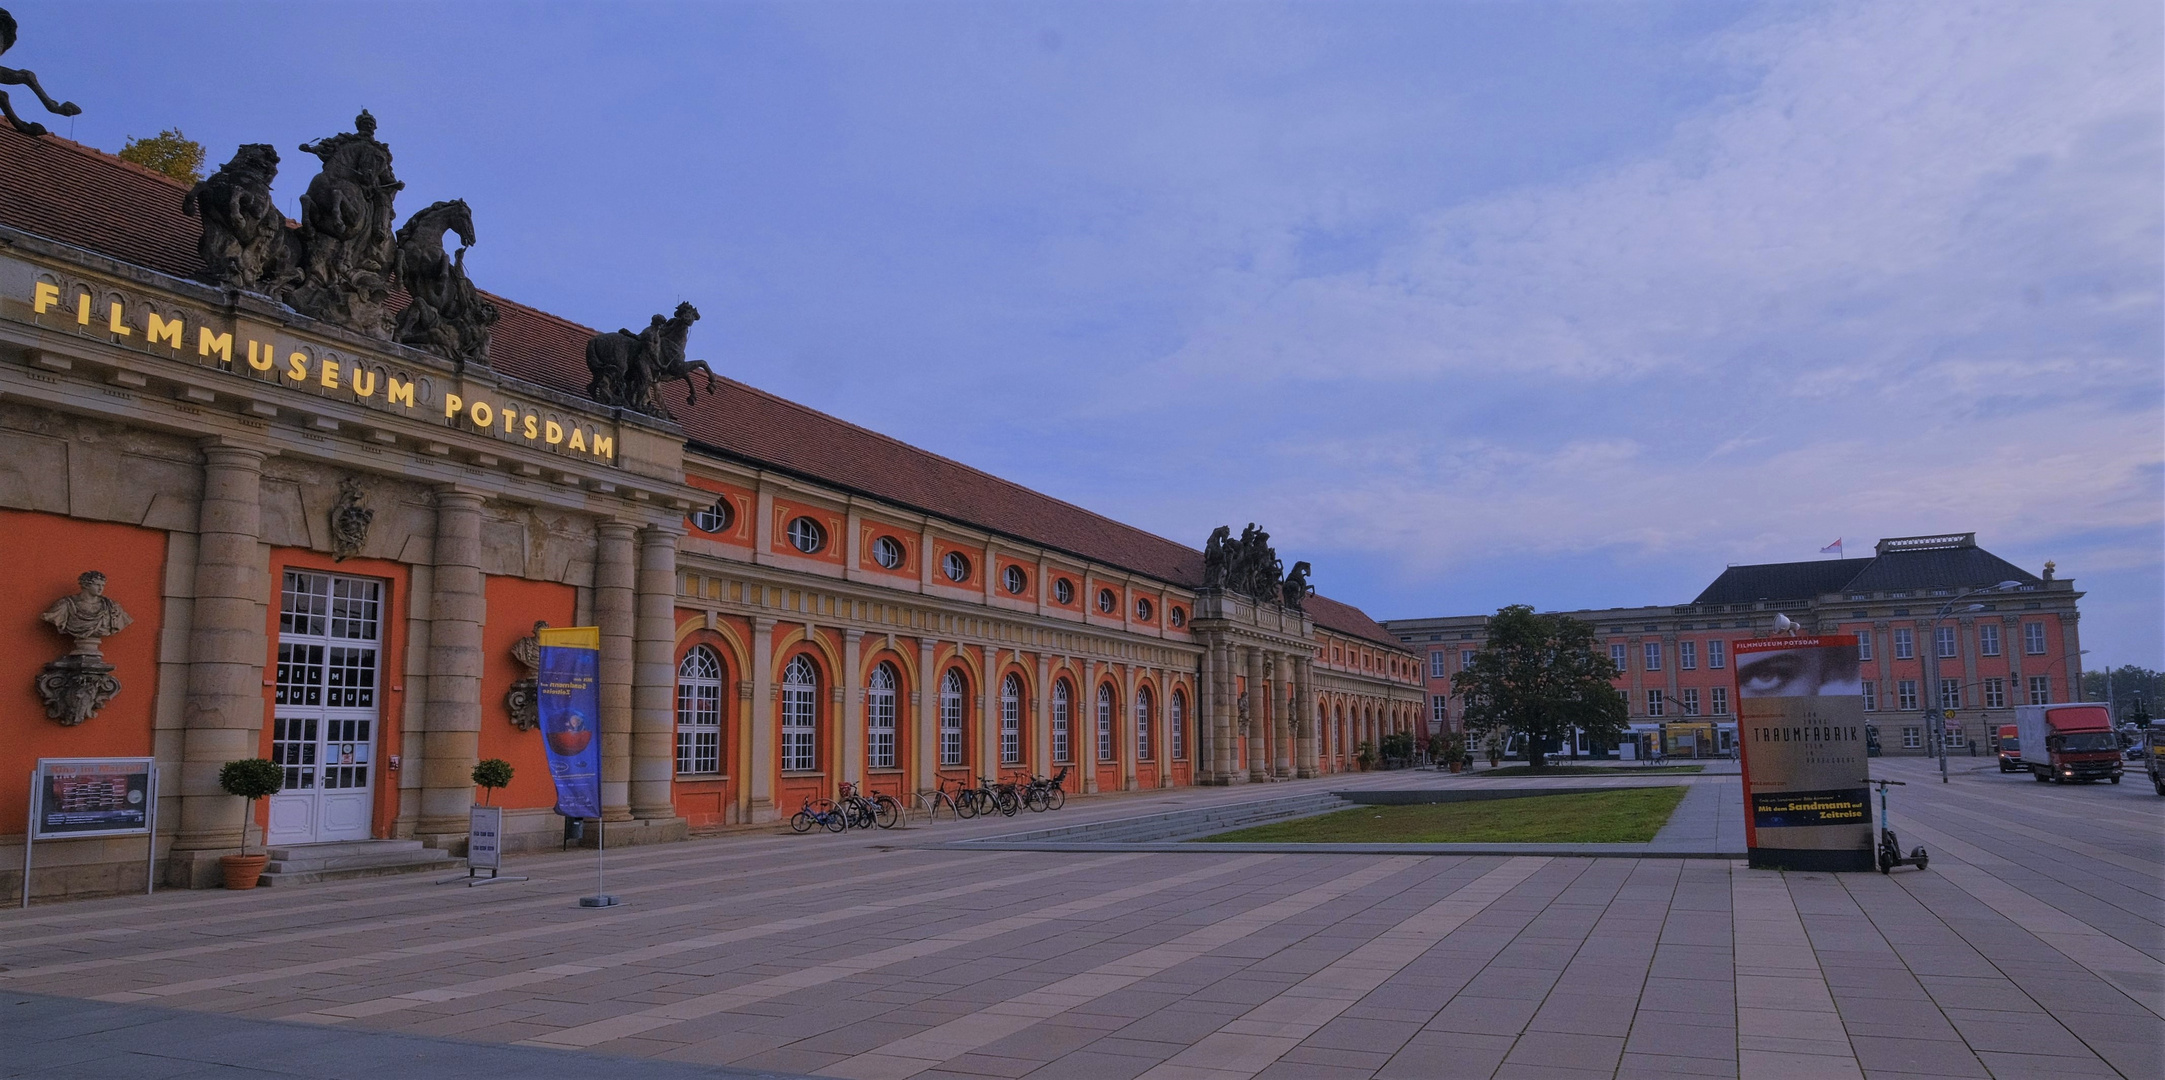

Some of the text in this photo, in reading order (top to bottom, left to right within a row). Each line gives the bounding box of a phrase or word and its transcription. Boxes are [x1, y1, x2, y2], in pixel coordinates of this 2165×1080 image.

[34, 281, 613, 459] FILMMUSEUM POTSDAM
[1736, 640, 1783, 649] FILMMUSEUM
[278, 670, 339, 680] FILM
[276, 691, 369, 701] MUSEUM
[1754, 726, 1858, 742] TRAUMFABRIK
[1758, 805, 1773, 813] Mit
[1788, 801, 1852, 811] Sandmann
[1819, 810, 1863, 819] Zeitreise
